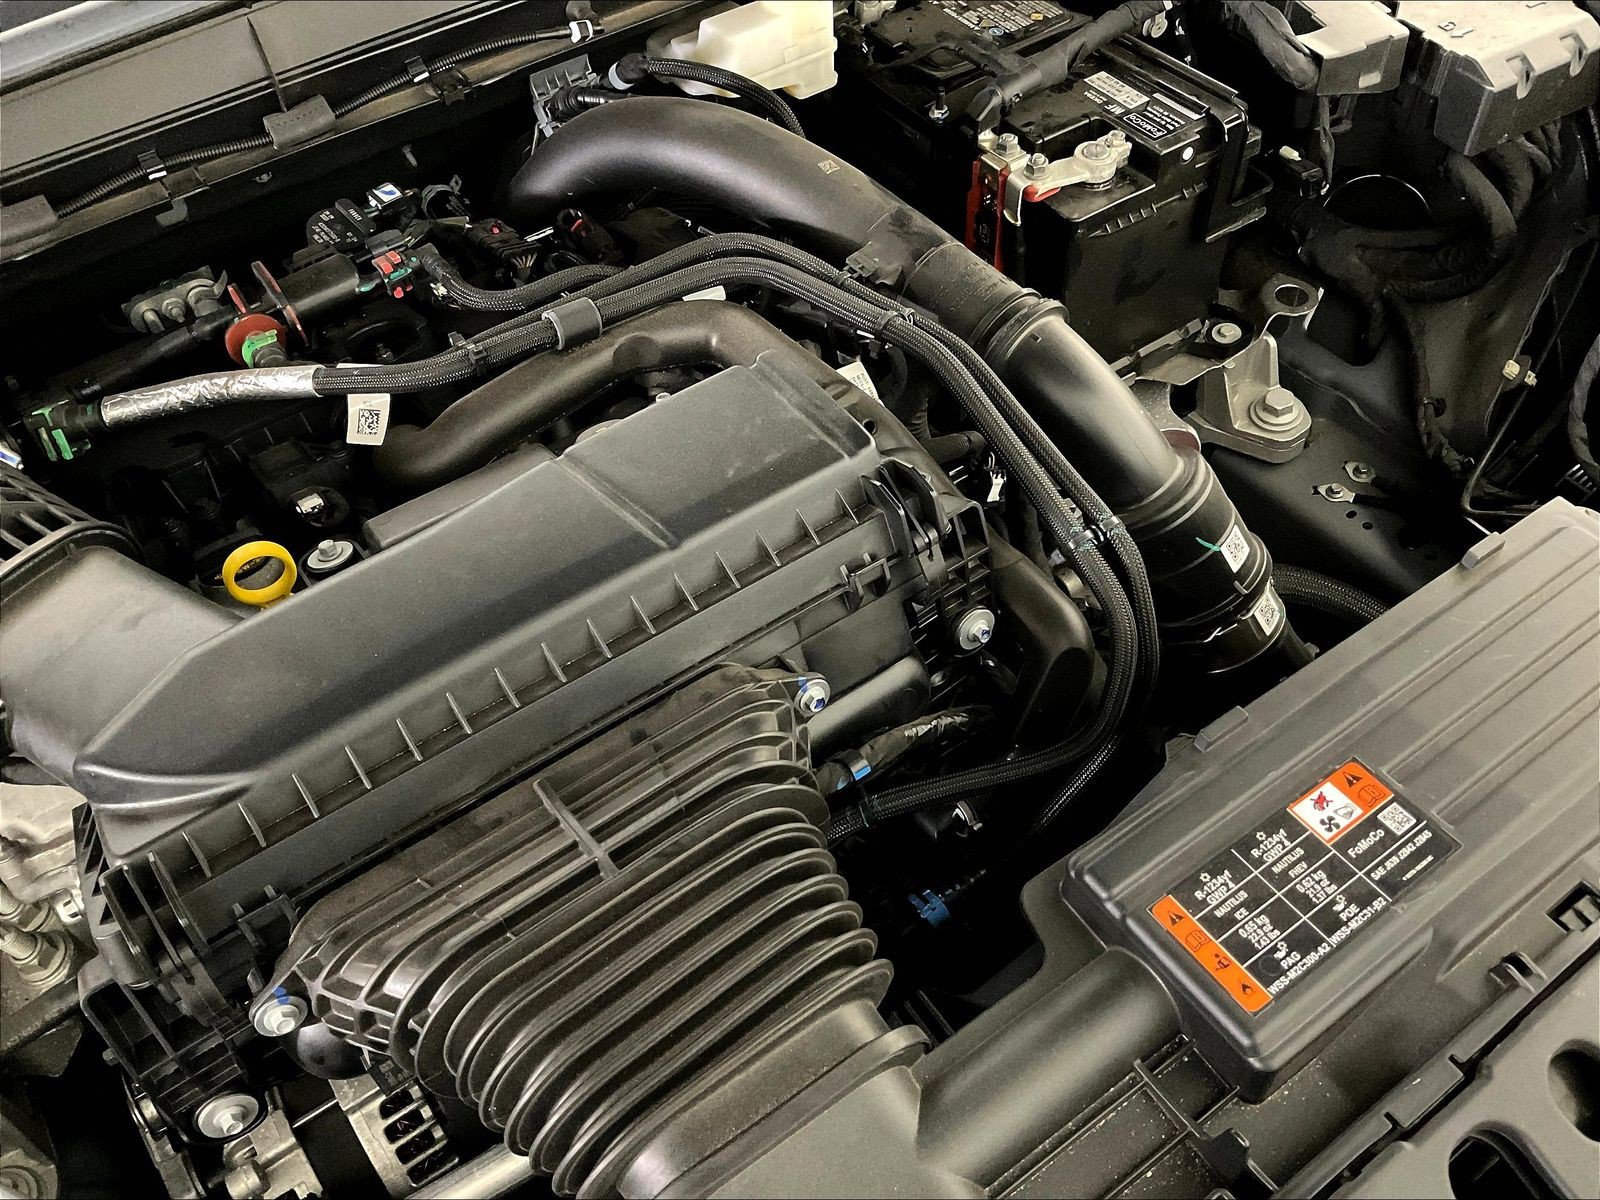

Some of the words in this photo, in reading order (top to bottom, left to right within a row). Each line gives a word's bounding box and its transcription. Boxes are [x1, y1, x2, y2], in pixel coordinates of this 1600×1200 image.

[1129, 114, 1164, 136] FoMoCo
[1250, 828, 1288, 858] R-1234yf
[1262, 844, 1283, 862] GWP
[1347, 829, 1385, 858] FoMoCo
[1271, 847, 1304, 874] NAUTILUS
[1370, 866, 1387, 880] SAE
[1384, 855, 1400, 871] J639
[1398, 842, 1416, 860] J2842
[1413, 829, 1432, 847] J2845
[1288, 861, 1307, 878] FHEV
[1194, 869, 1232, 900] R-1234yf
[1296, 877, 1315, 893] 0.62
[1311, 870, 1327, 881] kg
[1305, 884, 1321, 898] 21.9
[1320, 879, 1330, 888] oz
[1206, 886, 1228, 904] GWP
[1213, 890, 1248, 918] NAUTILUS
[1312, 891, 1327, 904] 1.37
[1324, 884, 1338, 895] lbs
[1233, 907, 1249, 920] ICE
[1329, 896, 1387, 944] WSS-M2C31-B2
[1339, 903, 1360, 921] POE
[1238, 920, 1257, 938] 0.65
[1254, 914, 1270, 926] kg
[1248, 929, 1264, 943] 22.9
[1263, 924, 1273, 932] oz
[1254, 936, 1270, 950] 1.43
[1267, 929, 1281, 940] lbs
[1267, 942, 1331, 994] WSS-M2C300-A2
[1280, 951, 1301, 969] PAG
